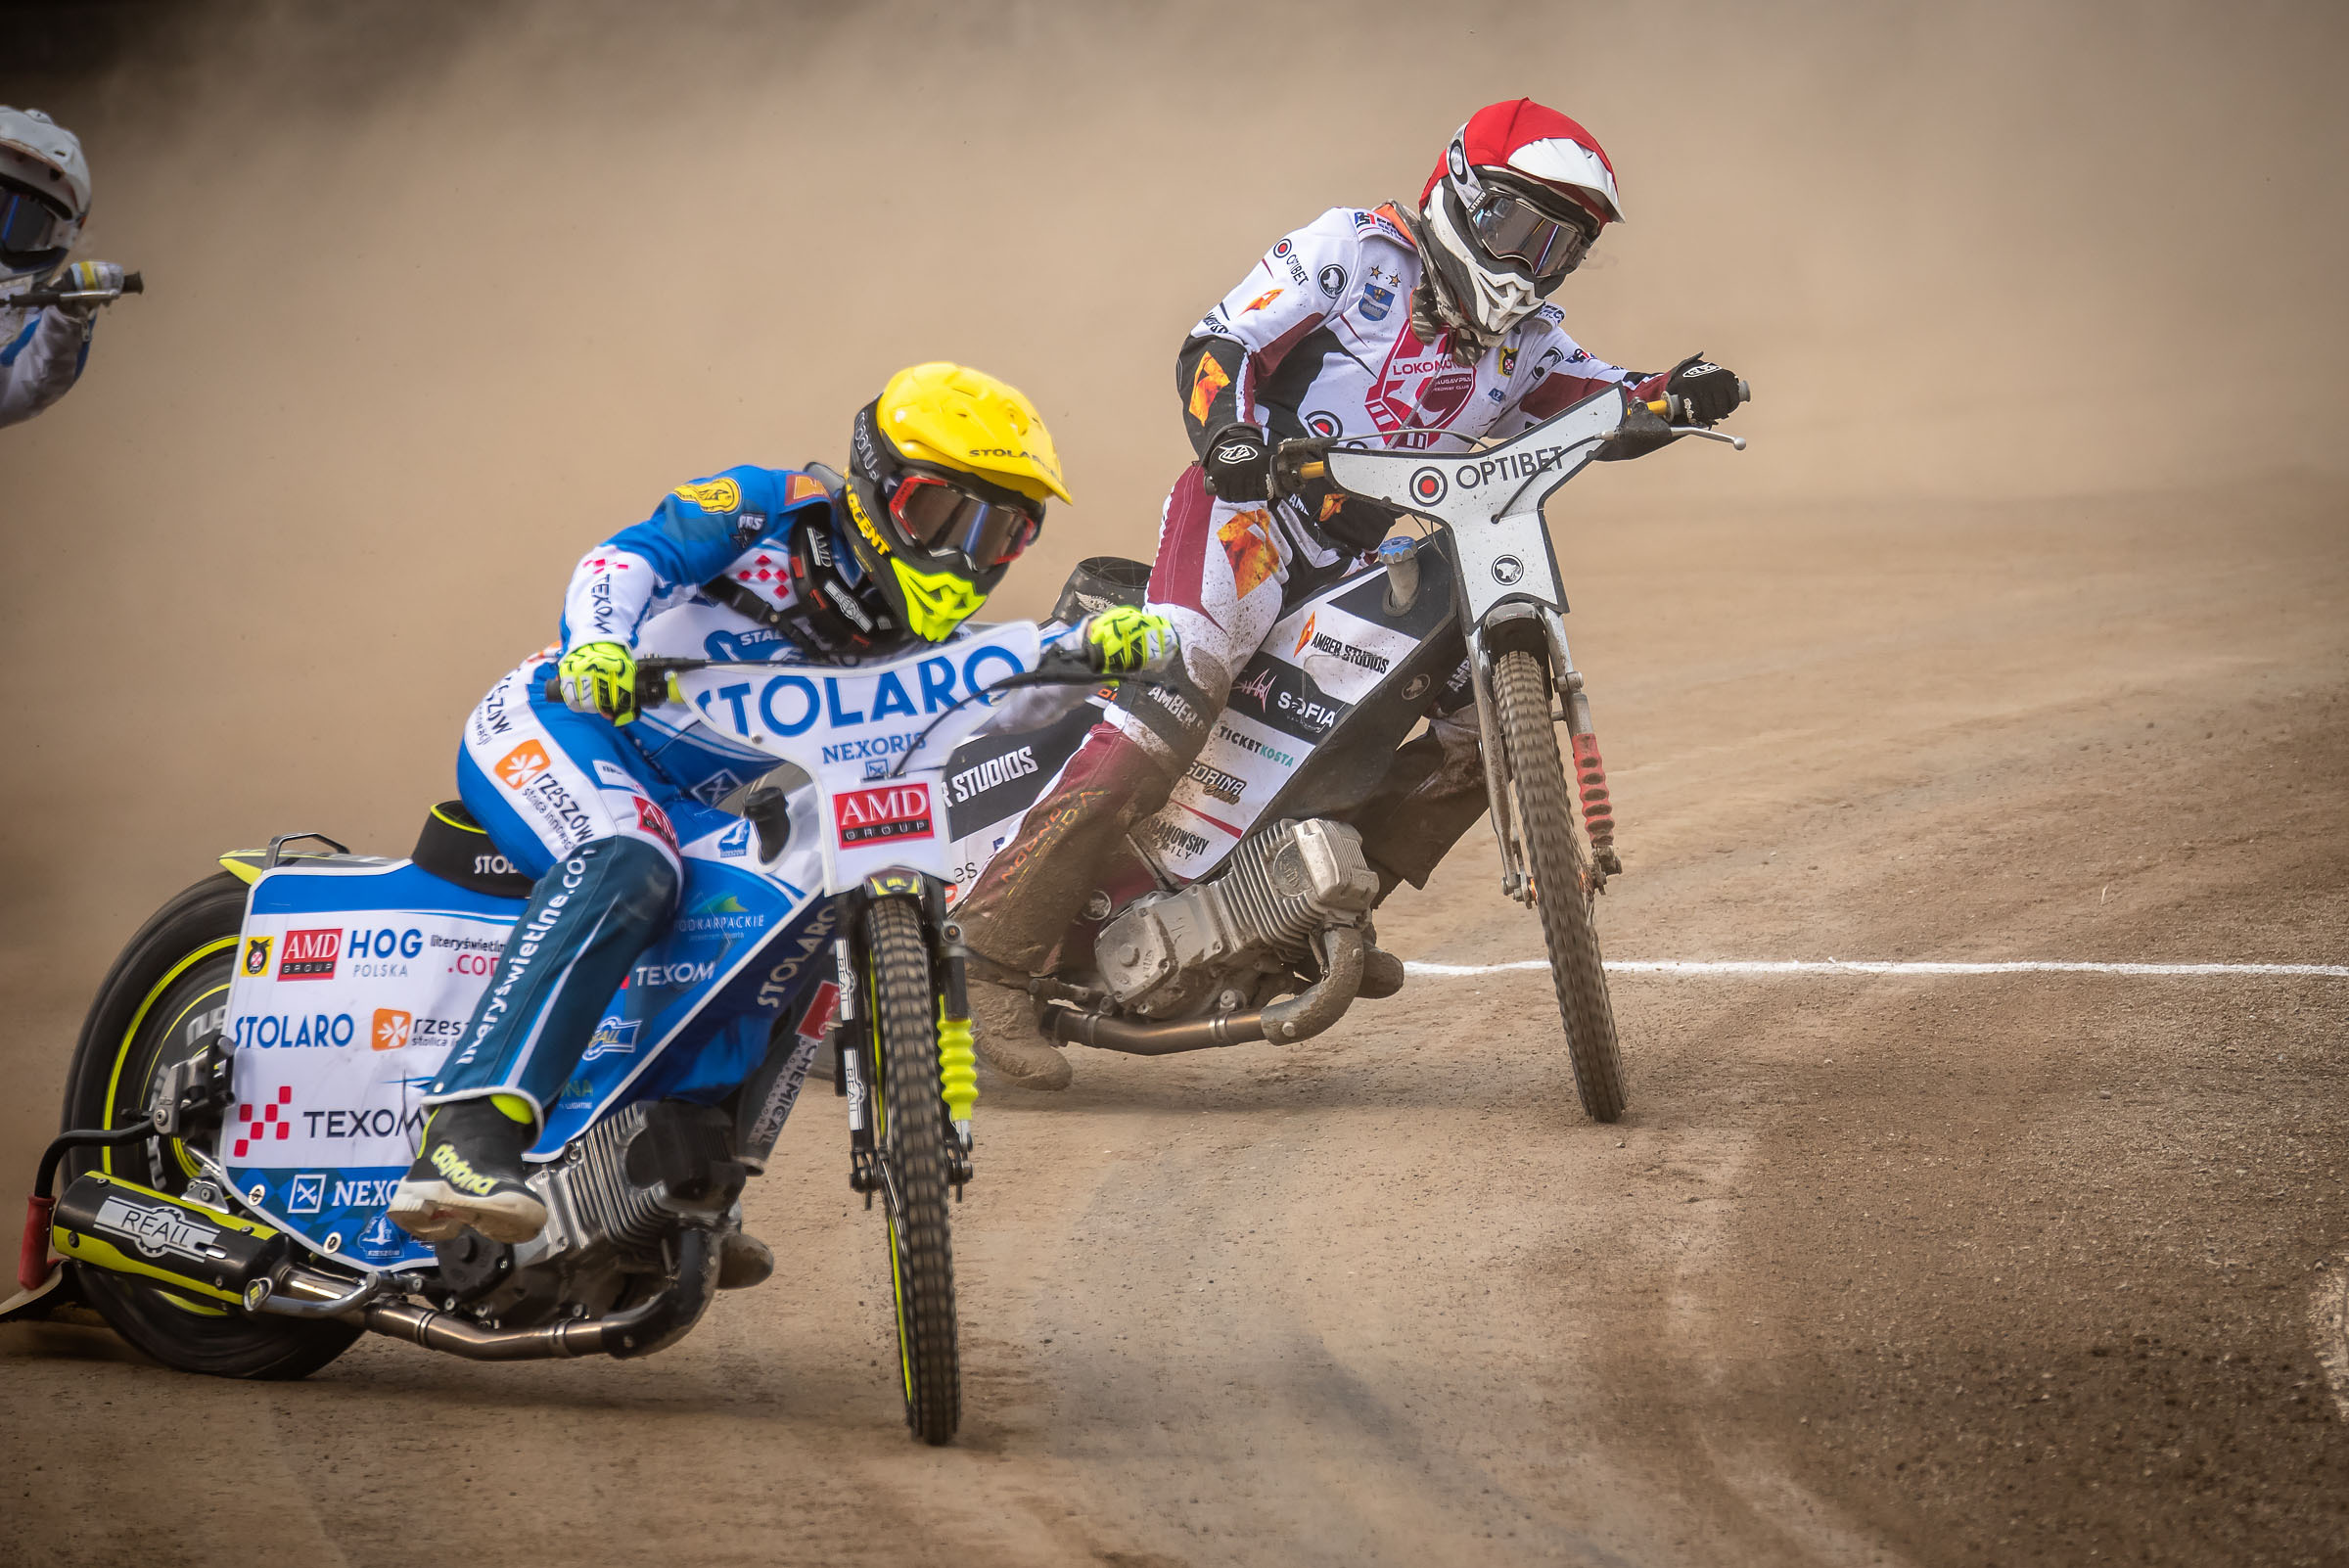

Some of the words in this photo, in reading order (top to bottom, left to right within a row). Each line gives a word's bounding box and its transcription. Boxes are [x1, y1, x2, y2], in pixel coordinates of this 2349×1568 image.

[1455, 445, 1563, 489] OPTIBET
[591, 574, 614, 634] TEXOM
[1311, 631, 1343, 657] AMBER
[1342, 644, 1390, 674] STUDIOS
[821, 732, 927, 764] NEXORIS
[1219, 725, 1295, 767] TICKETKOSTA
[951, 746, 1038, 803] STUDIOS
[532, 772, 595, 844] rzeszów
[840, 788, 928, 828] AMD
[845, 820, 926, 841] GROUP
[283, 934, 340, 959] AMD
[347, 929, 424, 959] HOG
[282, 962, 334, 974] GROUP
[353, 963, 408, 977] POLSKA
[635, 961, 716, 987] TEXOM
[234, 1012, 355, 1049] STOLARO
[759, 1043, 818, 1146] CHEMICAL
[431, 1143, 502, 1196] daytona
[120, 1210, 190, 1248] REALL
